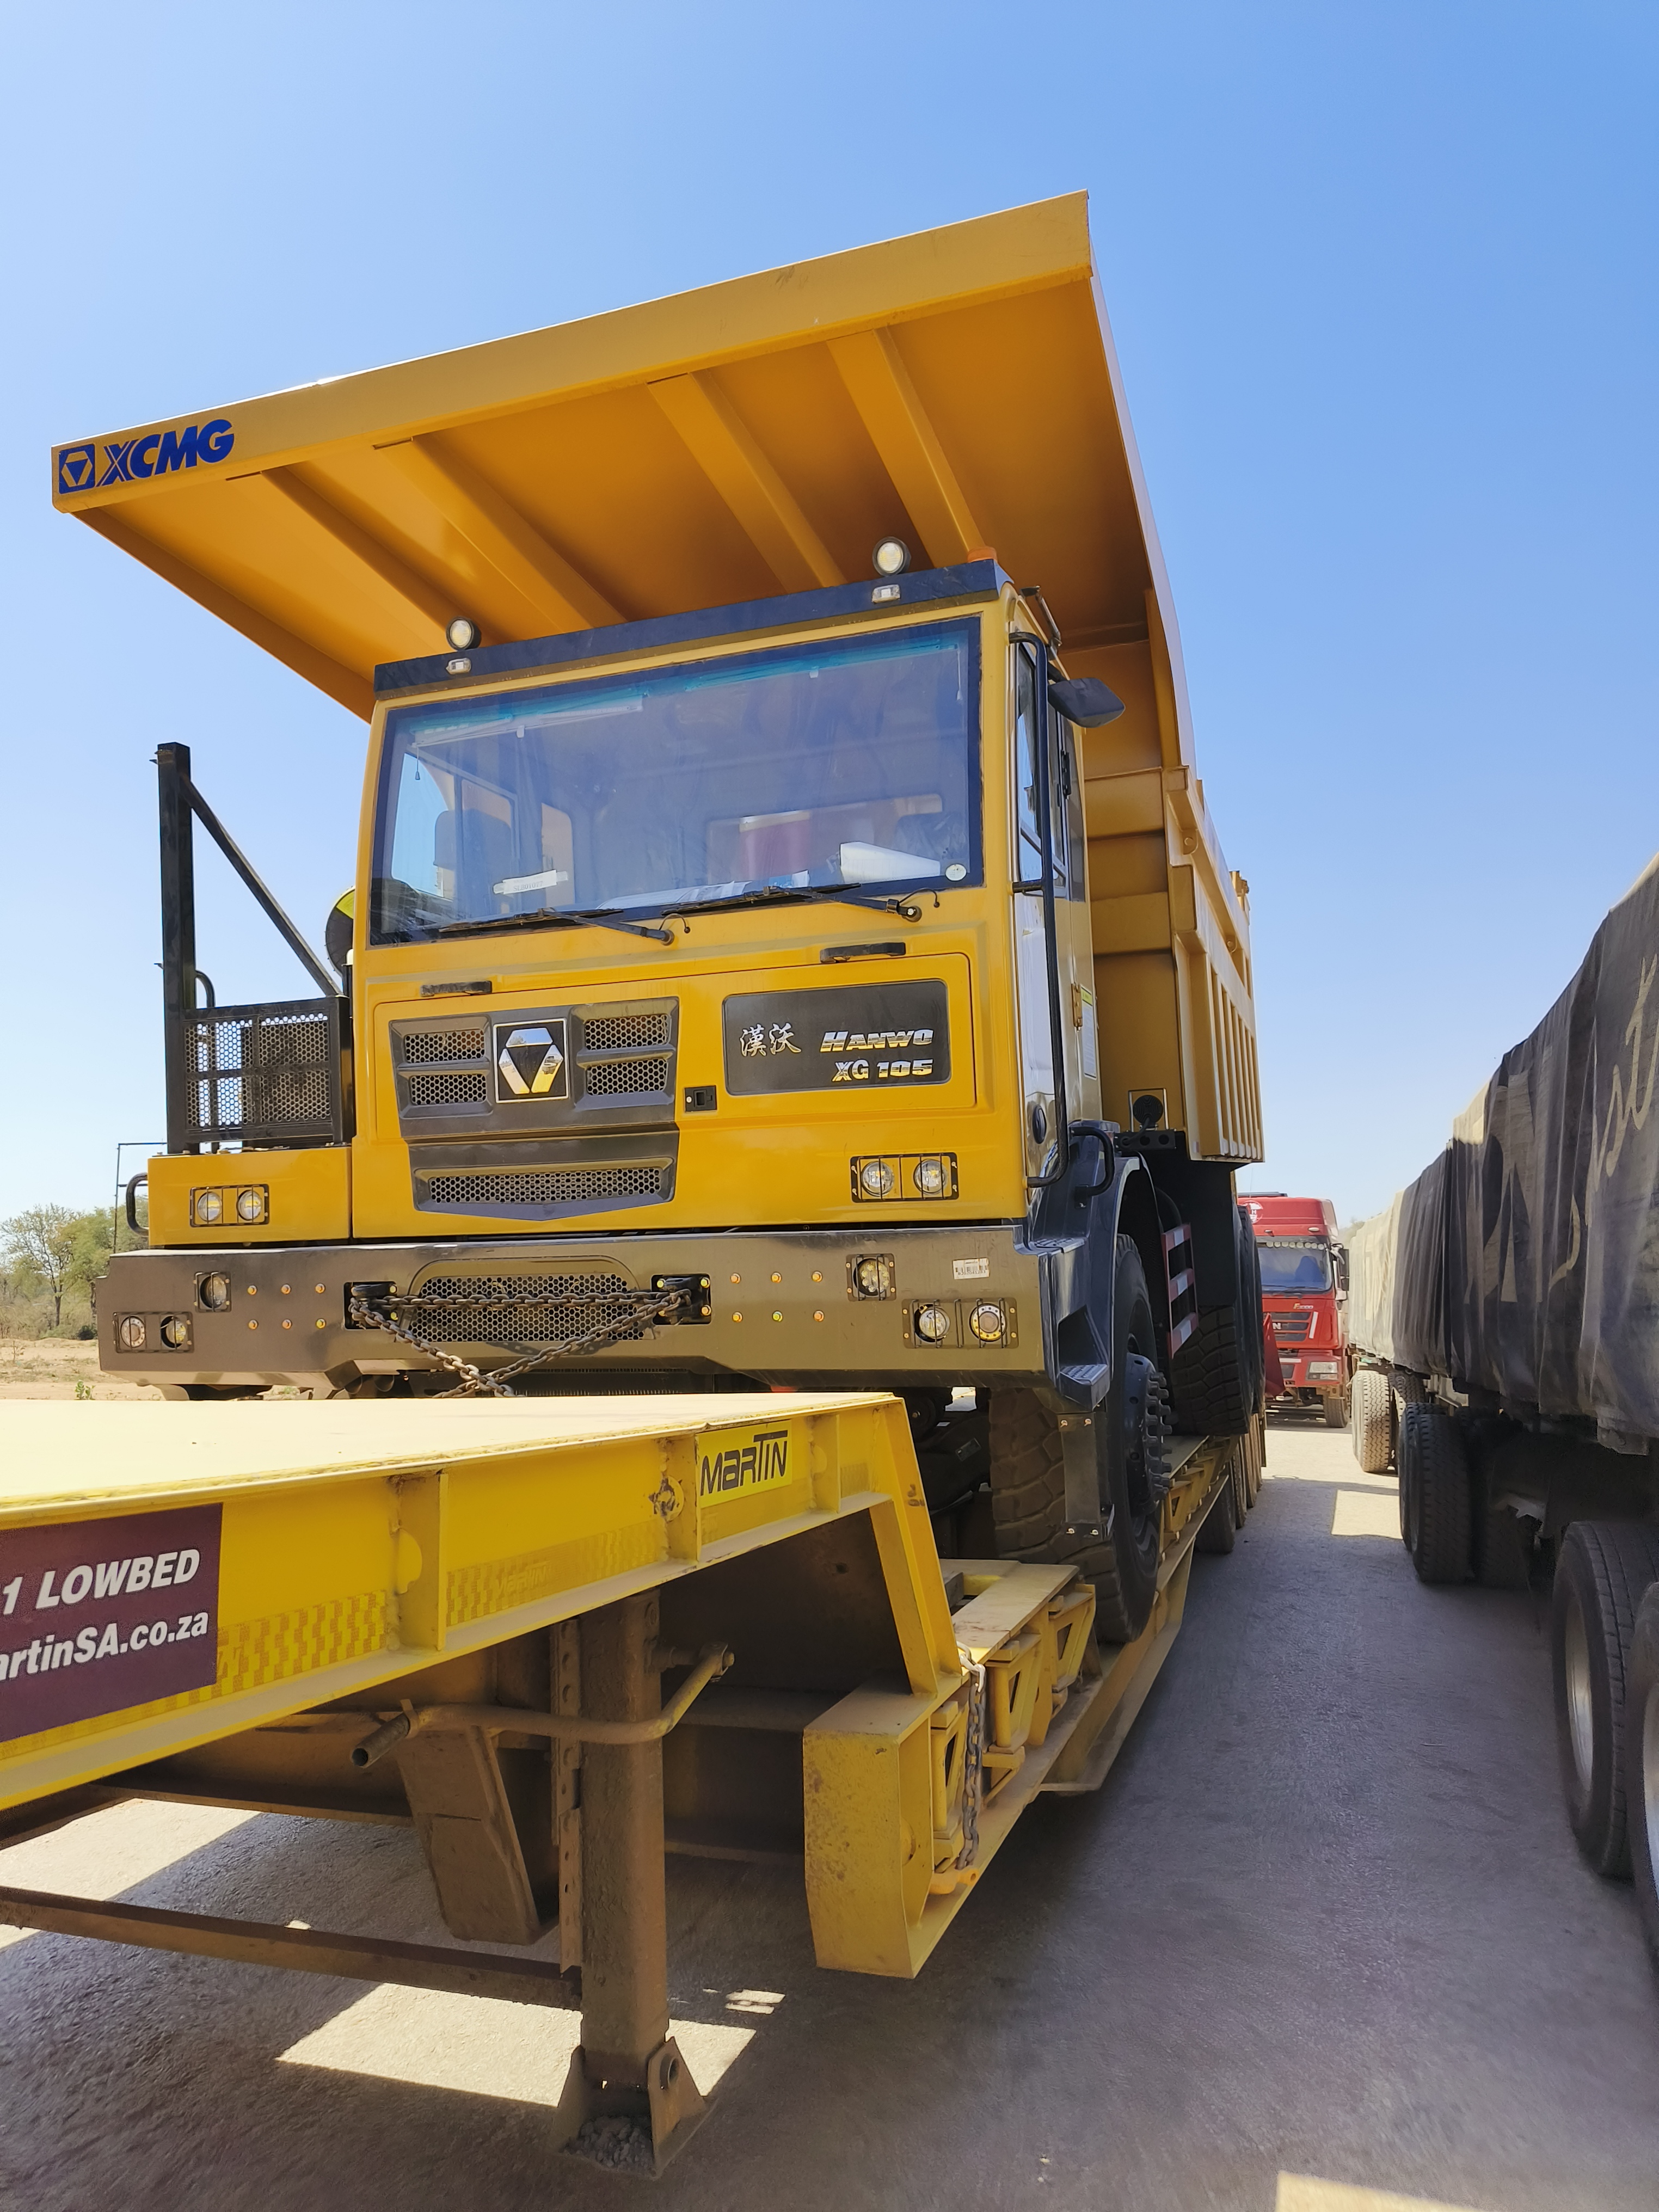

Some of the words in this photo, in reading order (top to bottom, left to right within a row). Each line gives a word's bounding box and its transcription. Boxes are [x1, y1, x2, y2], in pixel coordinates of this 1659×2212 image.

[96, 419, 235, 487] XCMG
[820, 1029, 933, 1052] HANWO
[832, 1059, 869, 1082] XG
[877, 1059, 933, 1078] 105
[35, 1549, 201, 1609] LOWBED
